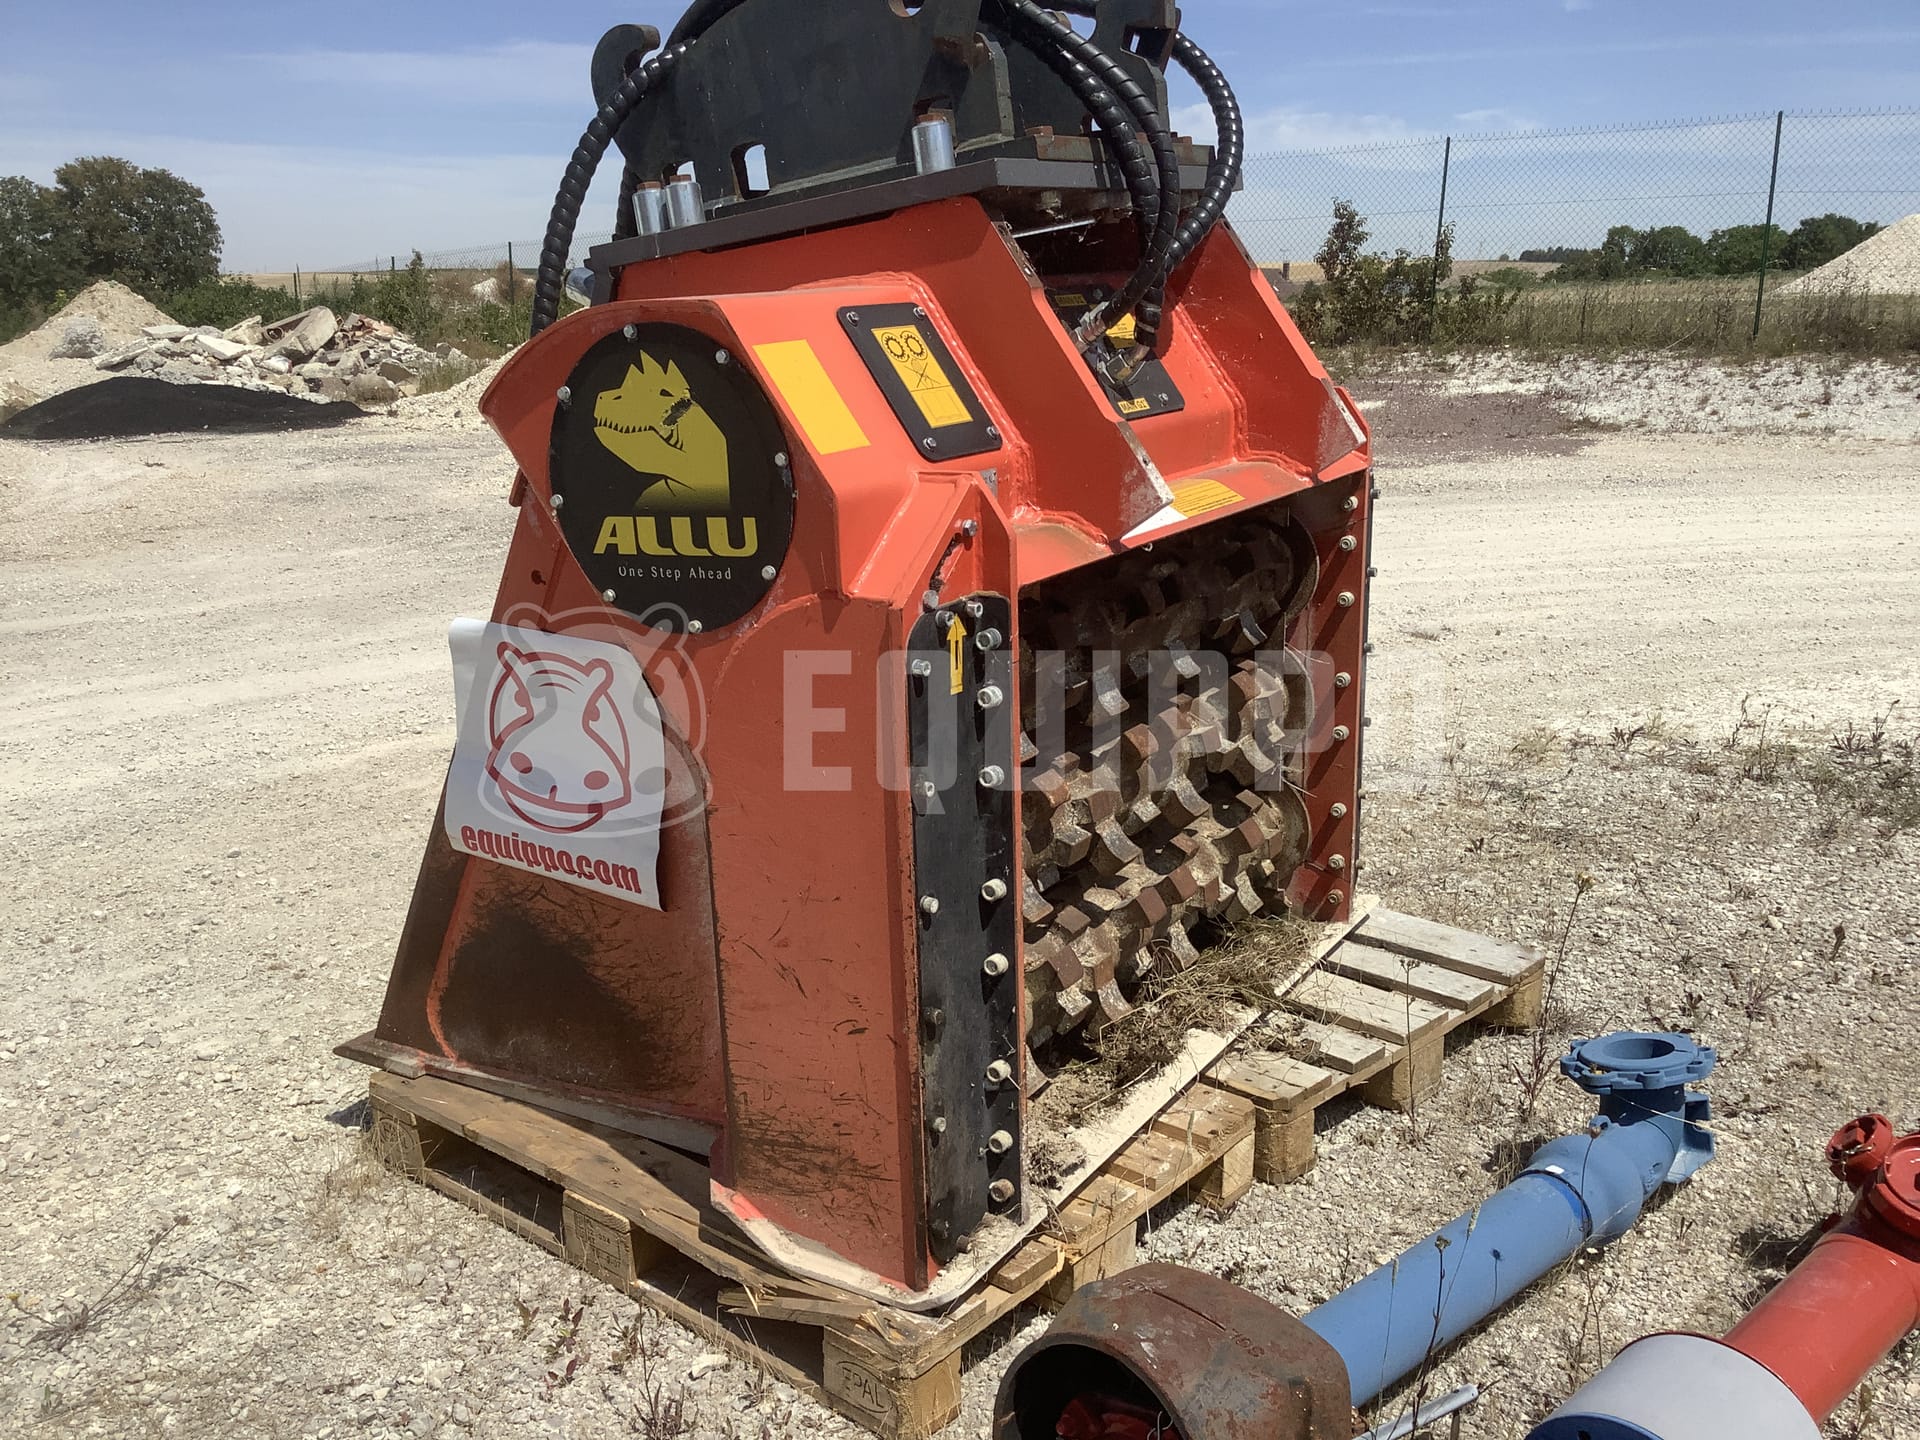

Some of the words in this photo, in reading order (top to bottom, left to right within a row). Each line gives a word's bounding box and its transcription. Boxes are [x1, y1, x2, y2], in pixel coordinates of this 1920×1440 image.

[593, 516, 759, 557] ALLU
[618, 566, 644, 577] One
[650, 567, 681, 581] Step
[689, 567, 732, 580] Ahead
[461, 825, 642, 894] equippo.com
